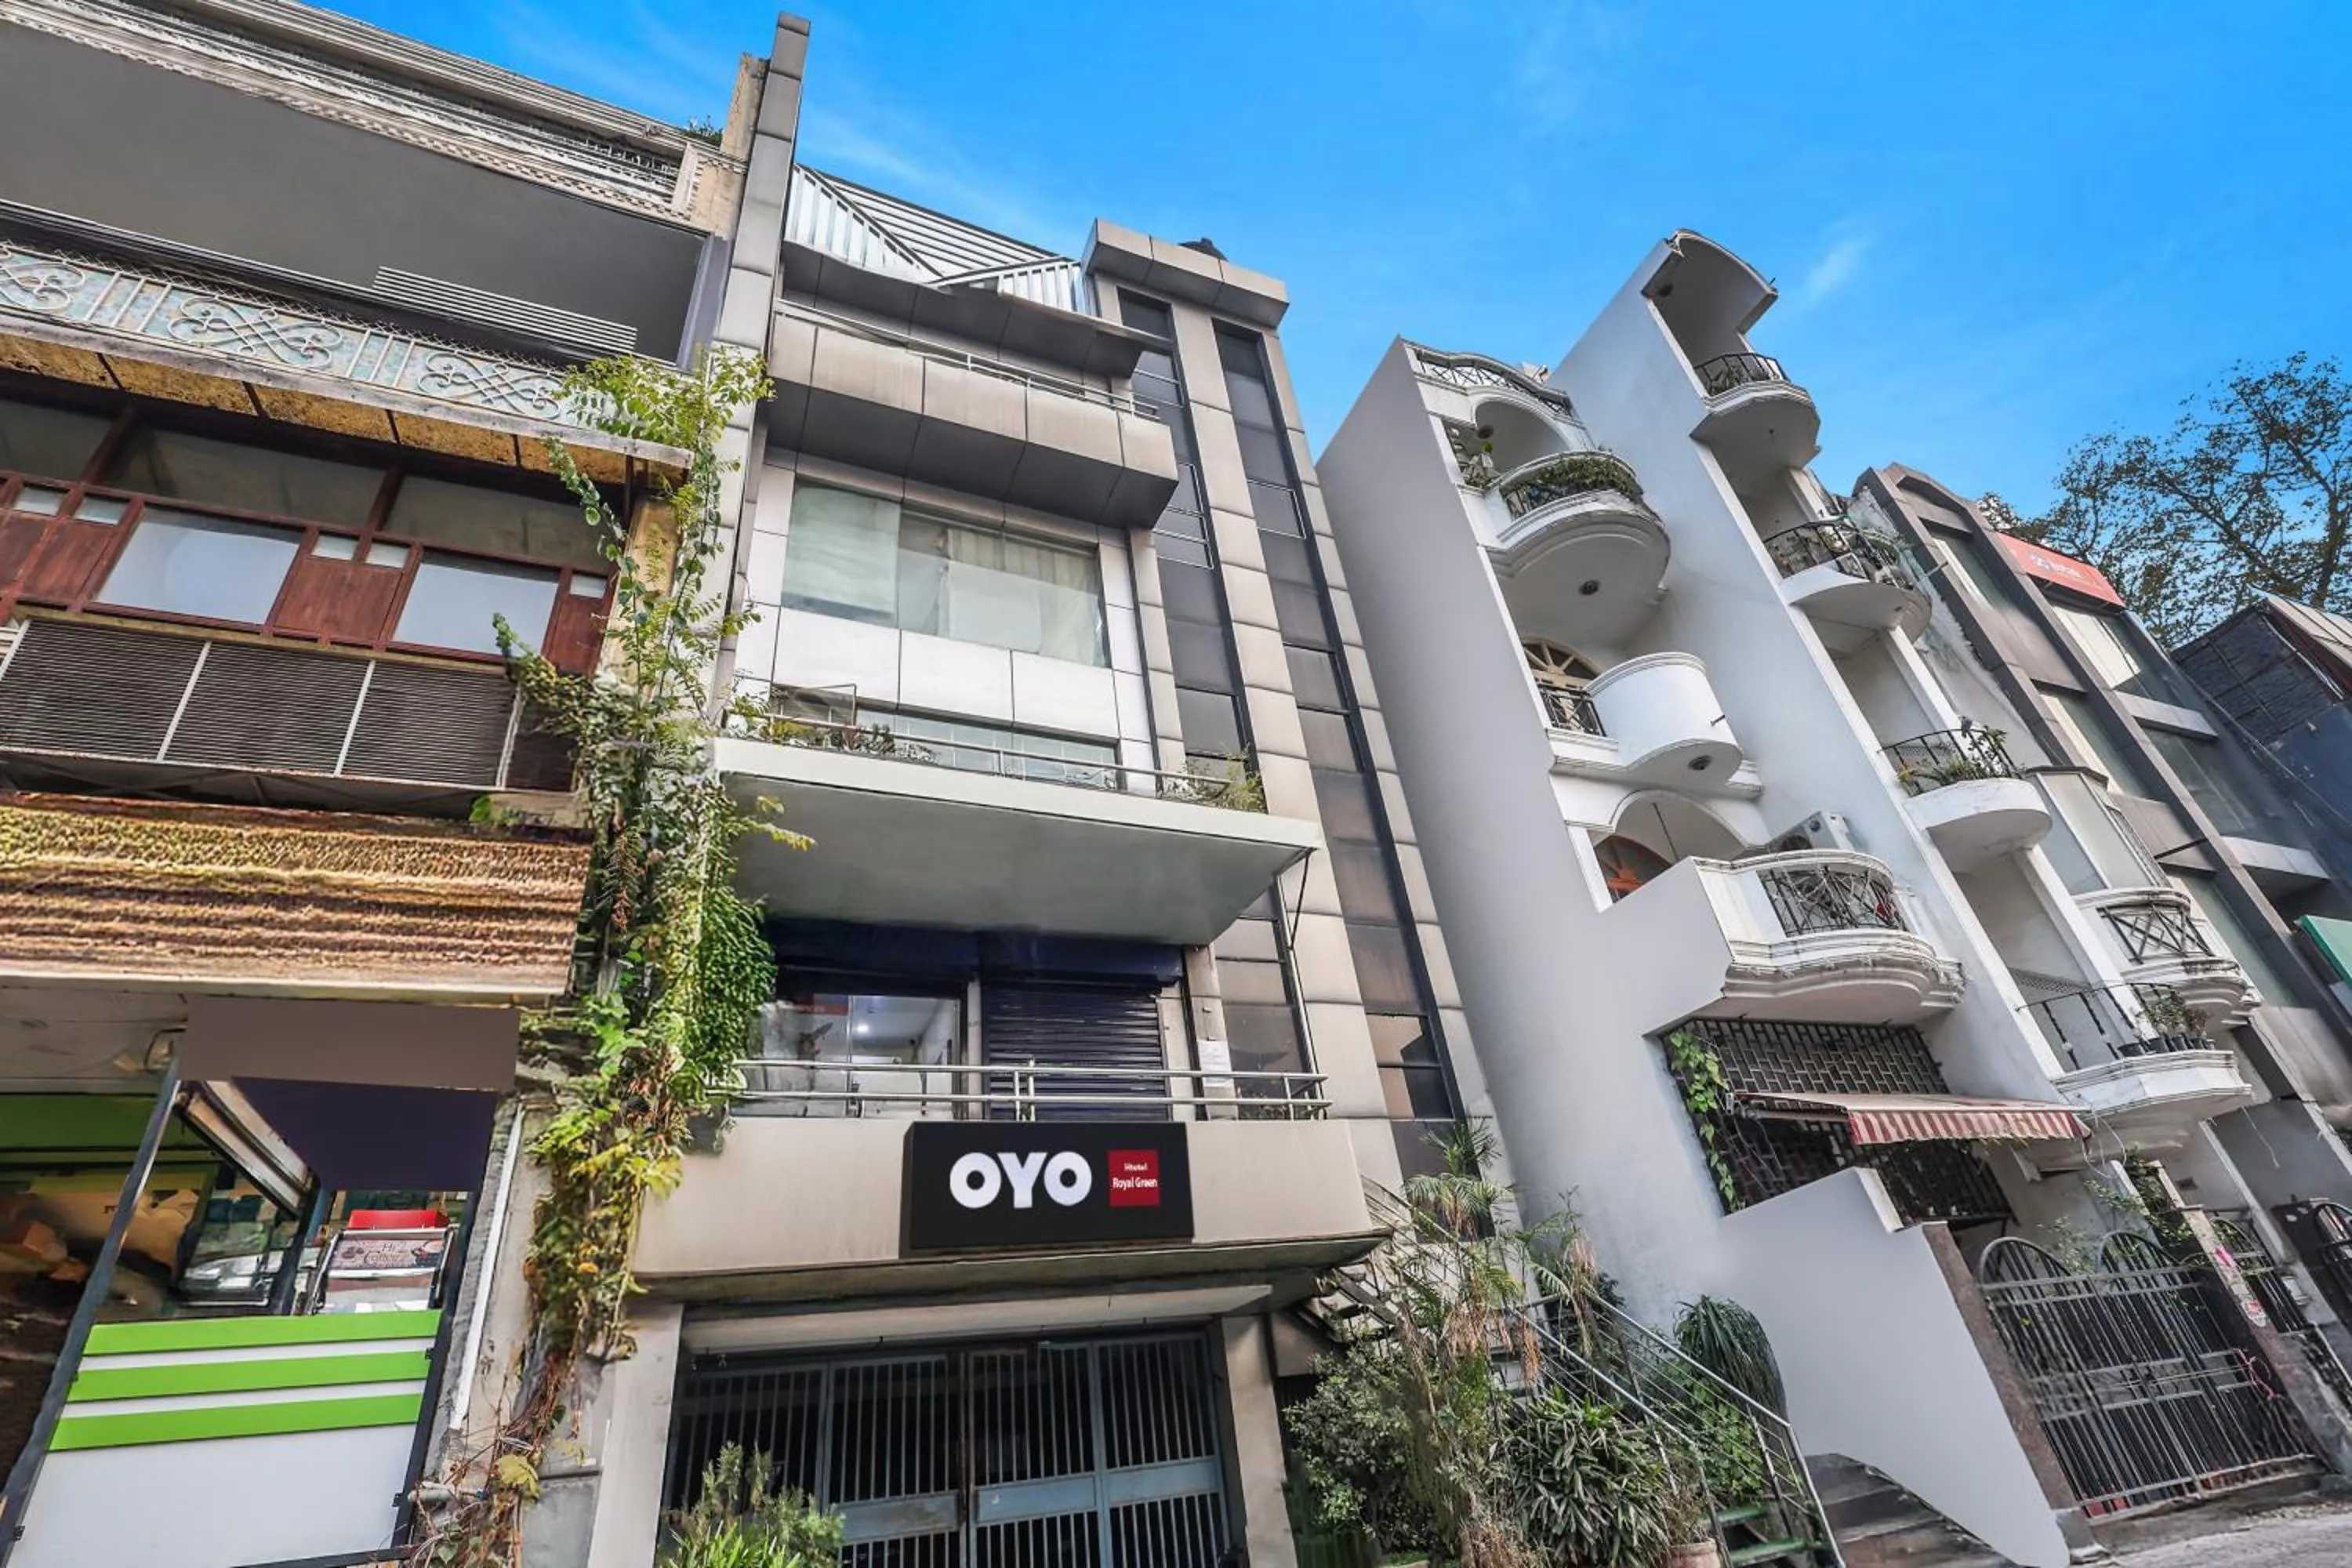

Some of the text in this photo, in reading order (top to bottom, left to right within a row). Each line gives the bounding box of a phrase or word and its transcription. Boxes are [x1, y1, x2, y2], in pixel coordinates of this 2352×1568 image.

[1123, 1162, 1148, 1171] Hotel
[949, 1151, 1091, 1209] OYO
[1112, 1176, 1158, 1191] Royal Green
